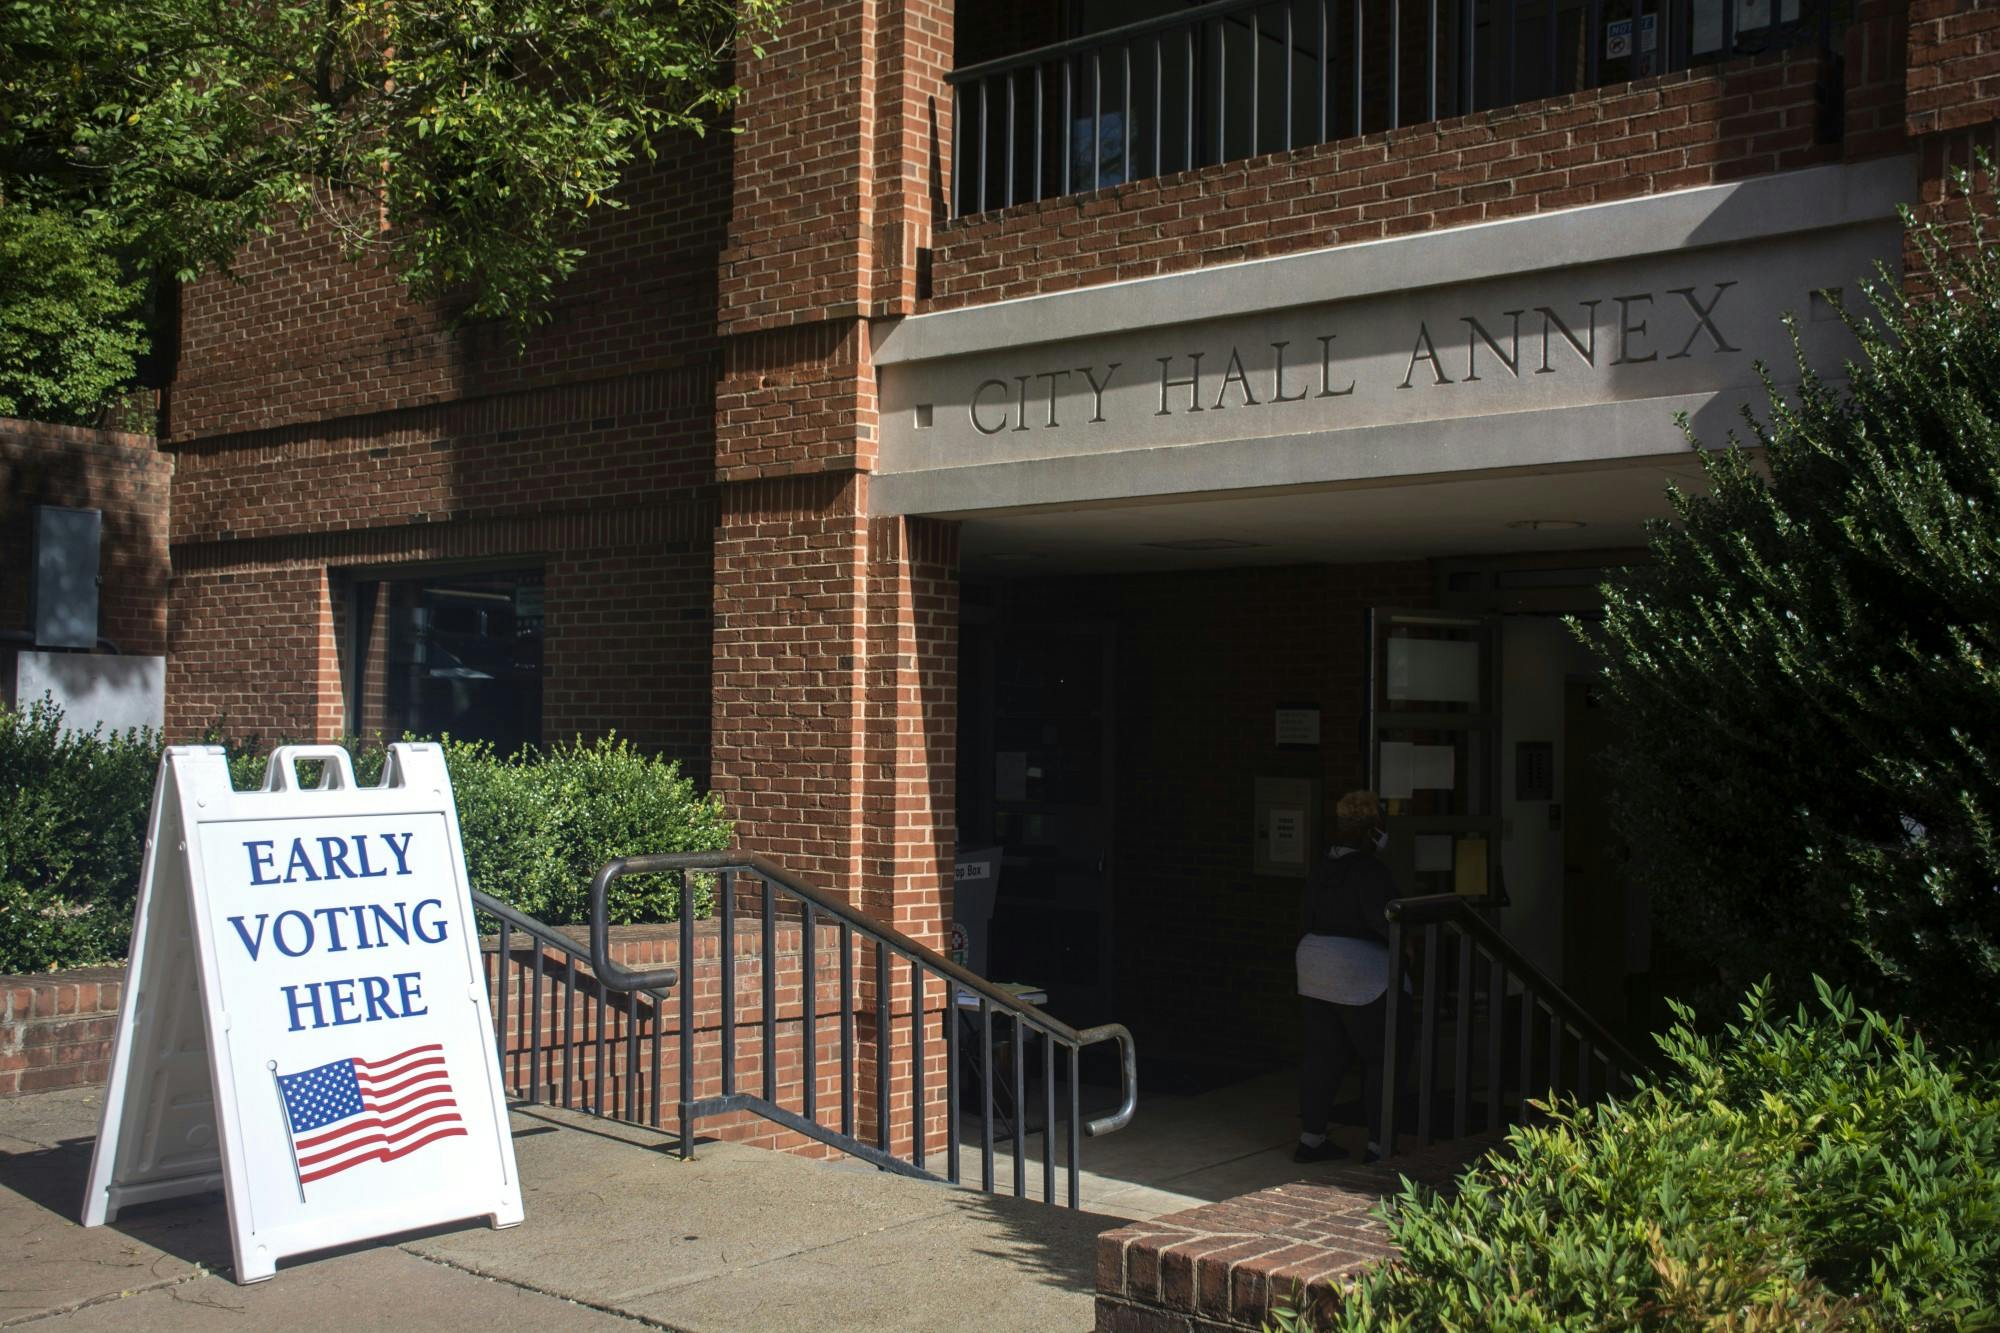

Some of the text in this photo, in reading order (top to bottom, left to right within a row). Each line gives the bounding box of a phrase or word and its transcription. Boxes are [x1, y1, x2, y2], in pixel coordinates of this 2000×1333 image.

[1612, 17, 1652, 36] NOTCE
[968, 280, 1743, 434] CITY HALL ANNEX
[242, 831, 413, 887] EARLY
[967, 864, 982, 877] Box
[227, 898, 449, 962] VOTING
[280, 971, 429, 1033] HERE
